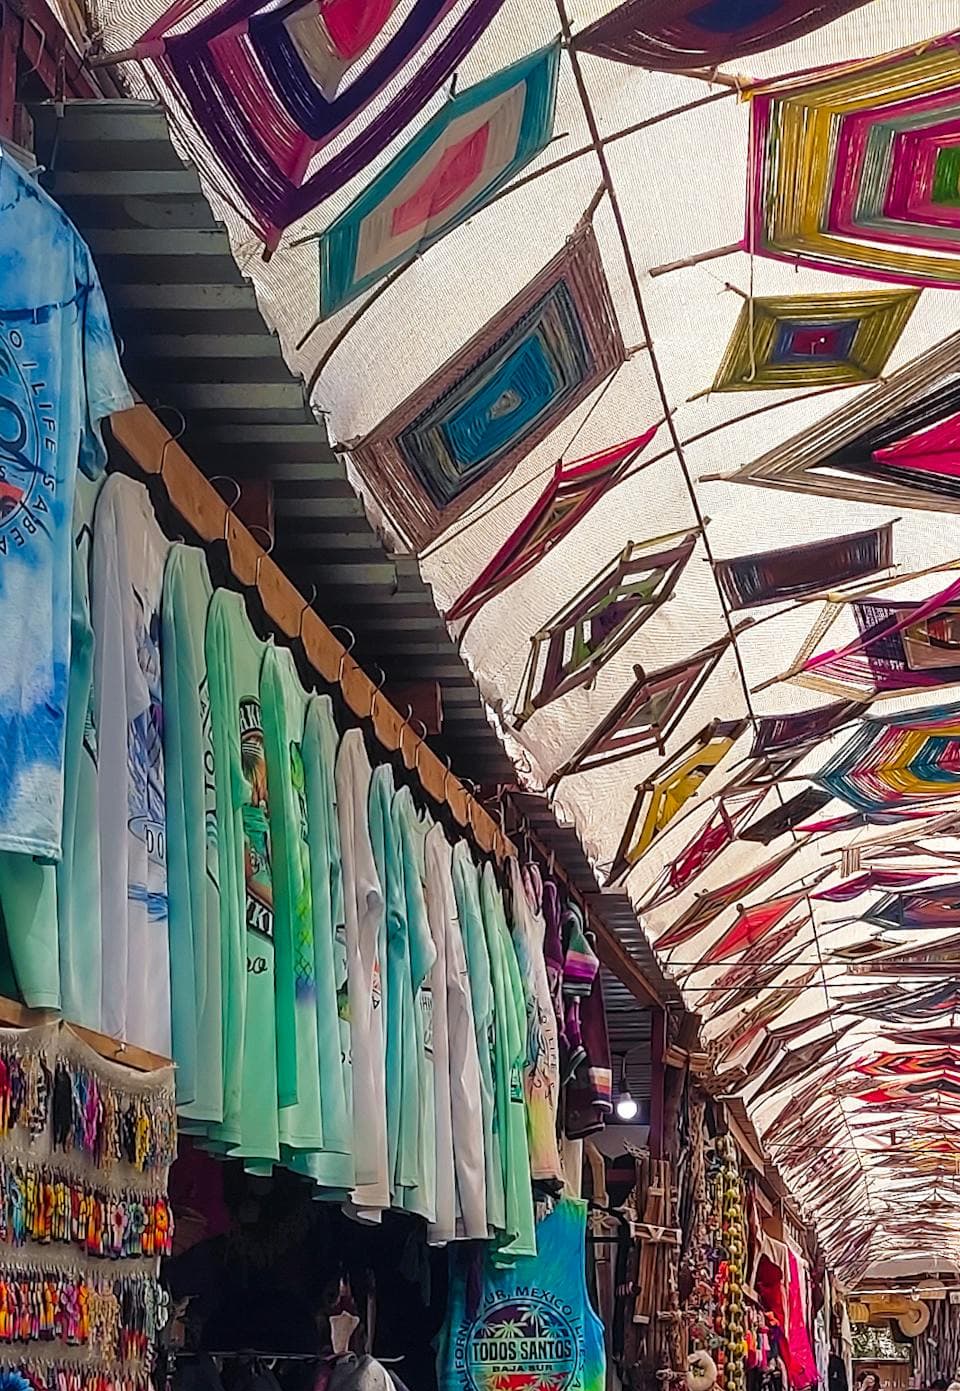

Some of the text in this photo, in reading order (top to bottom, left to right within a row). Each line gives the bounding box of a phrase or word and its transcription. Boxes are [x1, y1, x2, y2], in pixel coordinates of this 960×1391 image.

[516, 1286, 573, 1316] MEXICO
[472, 1339, 572, 1362] TODOS SANTOS
[492, 1365, 525, 1373] BAJA
